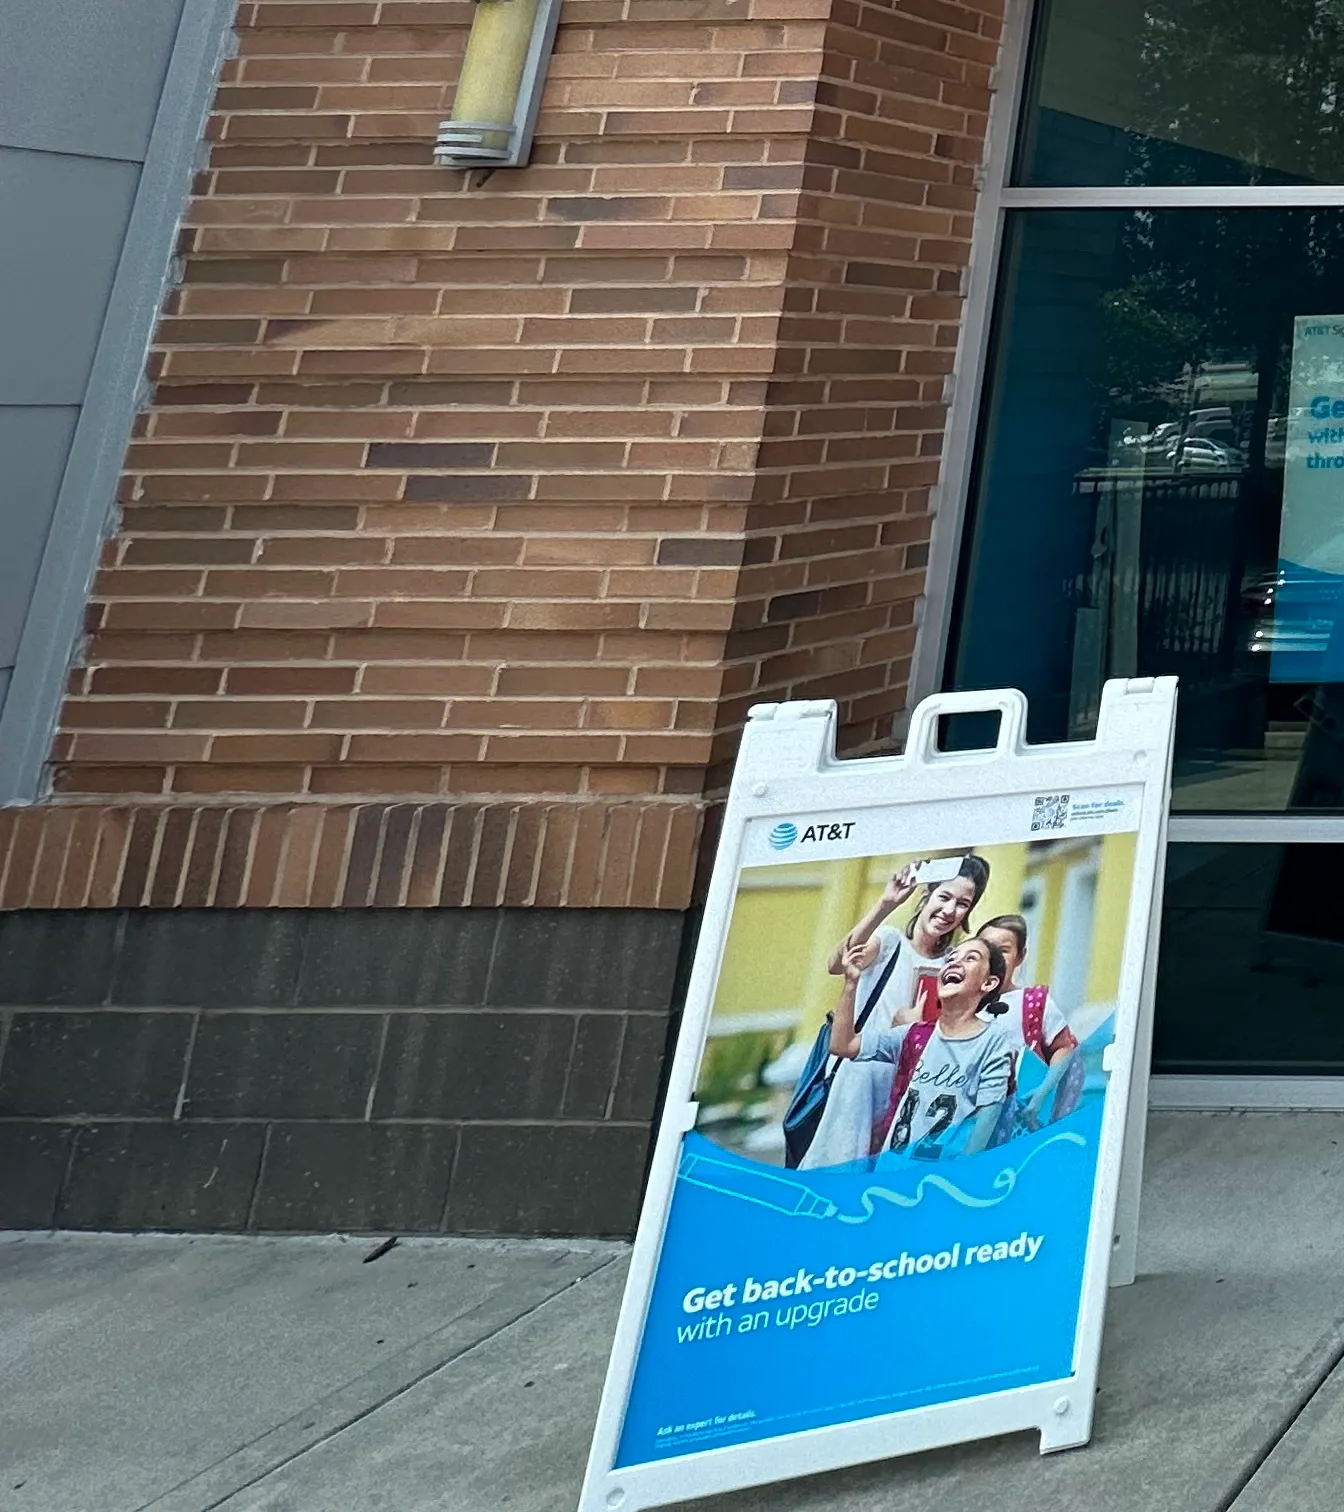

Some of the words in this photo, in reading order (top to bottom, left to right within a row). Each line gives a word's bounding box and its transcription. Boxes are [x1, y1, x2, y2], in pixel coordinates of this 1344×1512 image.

[800, 822, 856, 843] AT&T
[682, 1284, 738, 1314] Get
[742, 1243, 959, 1305] back-to-school
[964, 1231, 1044, 1265] ready
[676, 1311, 732, 1344] with
[737, 1308, 769, 1334] an
[775, 1287, 879, 1330] upgrade
[656, 1425, 673, 1436] Ask
[686, 1418, 713, 1431] expert
[714, 1415, 727, 1425] for
